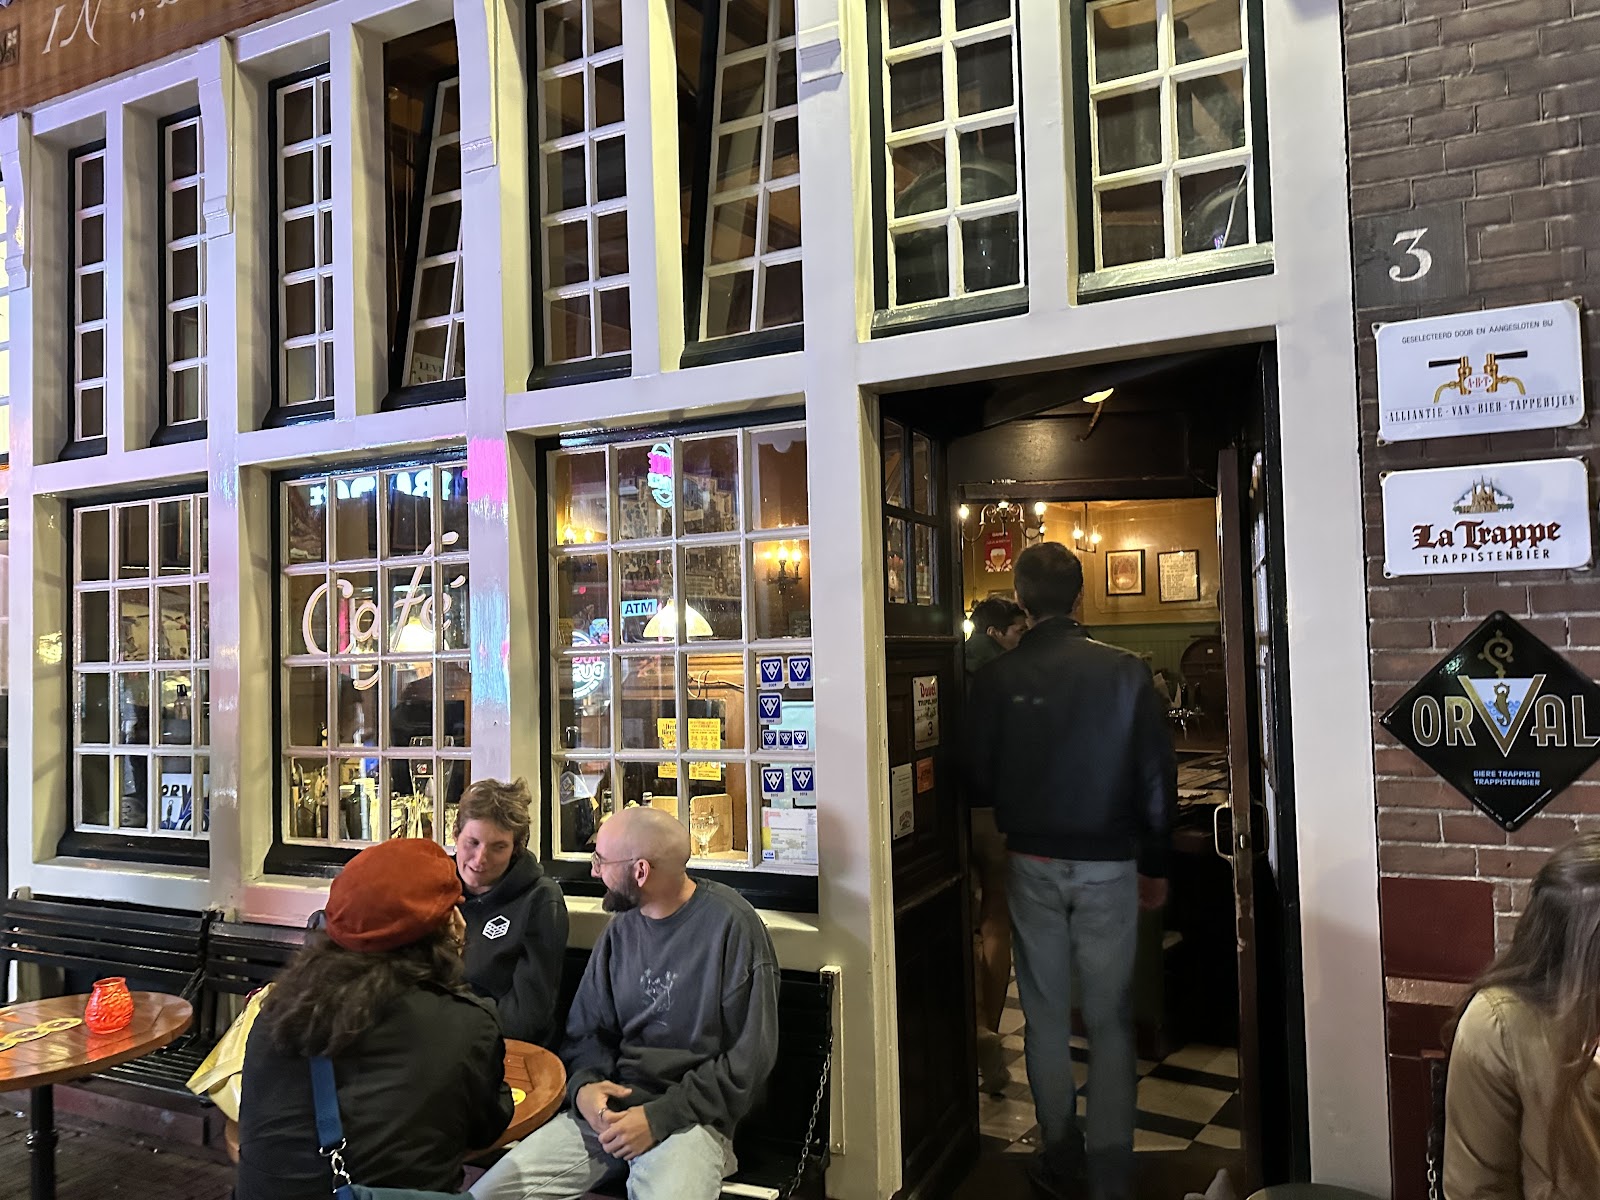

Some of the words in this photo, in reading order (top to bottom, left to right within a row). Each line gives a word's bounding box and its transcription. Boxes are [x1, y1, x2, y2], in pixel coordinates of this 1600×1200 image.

[1388, 227, 1433, 282] 3
[1401, 332, 1452, 344] GESELECTEERD
[1454, 329, 1474, 338] DOOR
[1476, 327, 1486, 335] EN
[1488, 321, 1540, 334] AANGESLOTEN
[1542, 319, 1553, 327] BIJ
[1388, 406, 1443, 423] ALLIANTIE
[1452, 404, 1470, 416] VAN
[1477, 401, 1502, 414] BIER
[1508, 395, 1575, 411] TAPPERIJEN
[1412, 524, 1454, 550] La
[1454, 520, 1561, 550] Trappe
[1423, 549, 1550, 565] TRAPPISTENBIER
[302, 531, 466, 691] Café
[1412, 674, 1600, 757] ORVAL
[1474, 778, 1540, 786] TRAPPISTENBIER
[1498, 770, 1540, 778] TRAPPISTE
